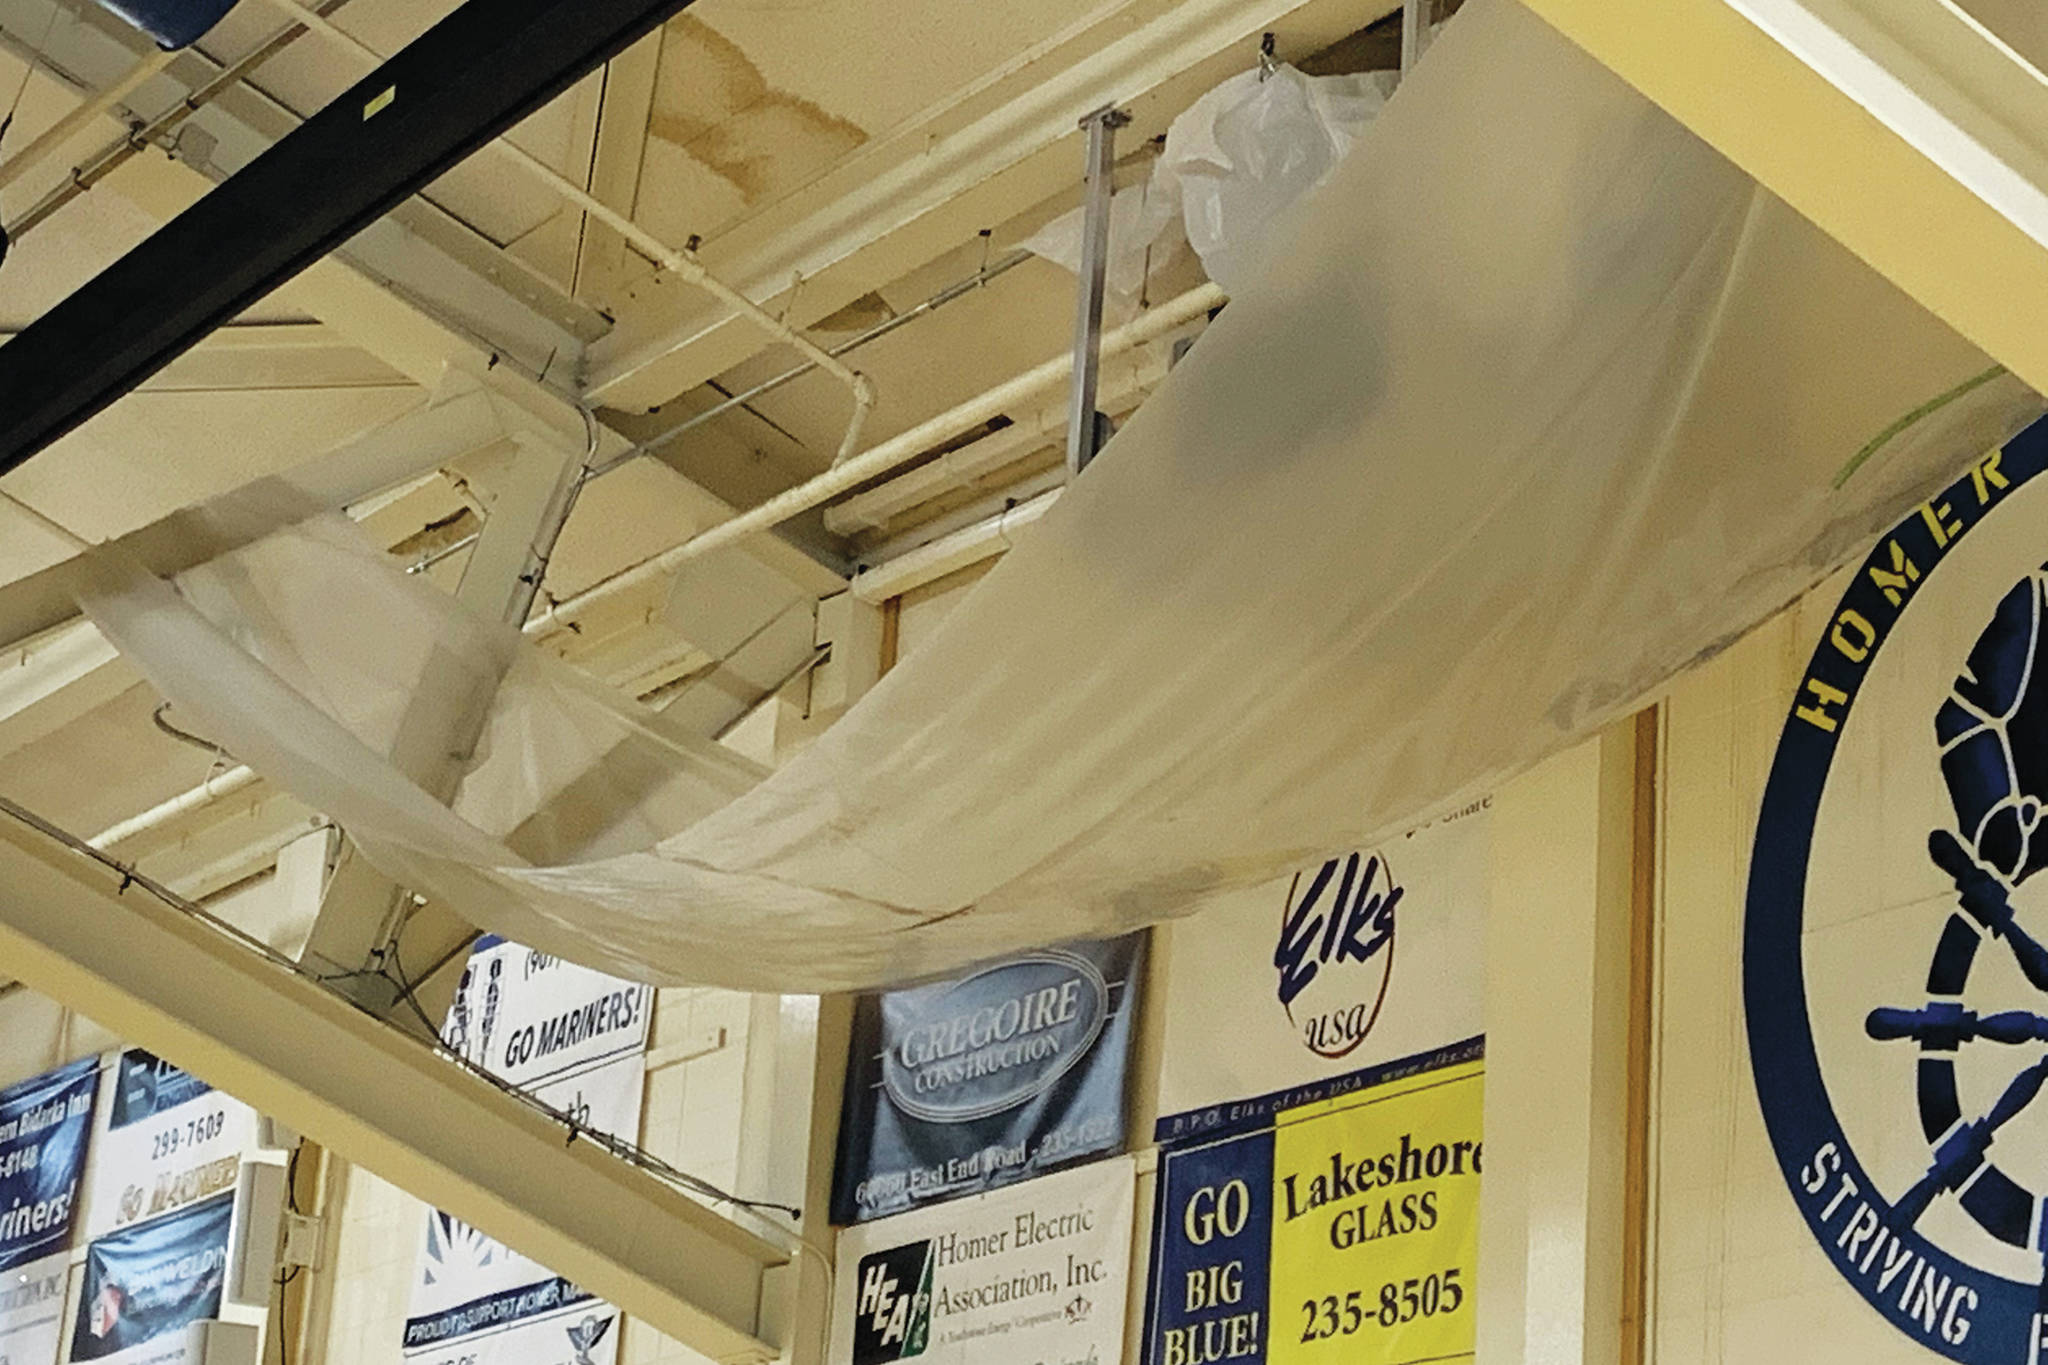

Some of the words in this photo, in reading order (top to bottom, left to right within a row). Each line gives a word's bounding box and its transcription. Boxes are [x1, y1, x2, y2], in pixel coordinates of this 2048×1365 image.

[1795, 450, 2010, 733] HOMER
[1274, 852, 1404, 1005] Elks
[505, 1025, 534, 1069] GO
[535, 984, 643, 1058] MARINERS!
[901, 979, 1082, 1068] GREGOIRE
[914, 1034, 1062, 1094] CONSTRUCTION
[151, 1109, 225, 1161] 299-7609
[910, 1164, 945, 1190] East
[947, 1155, 980, 1182] End
[981, 1139, 1027, 1171] Road
[936, 1230, 1009, 1268] Homer
[1014, 1203, 1094, 1248] Electric
[1183, 1178, 1250, 1246] GO
[1329, 1189, 1439, 1251] GLASS
[1801, 1141, 1979, 1346] STRIVING
[857, 1261, 911, 1347] HEA
[933, 1270, 1059, 1319] Association,
[1065, 1253, 1109, 1289] Inc.
[1183, 1259, 1244, 1313] BIG
[1299, 1267, 1464, 1345] 235-8505
[406, 1318, 449, 1344] PROUD
[465, 1298, 516, 1328] SUPPORT
[1163, 1311, 1260, 1365] BLUE!
